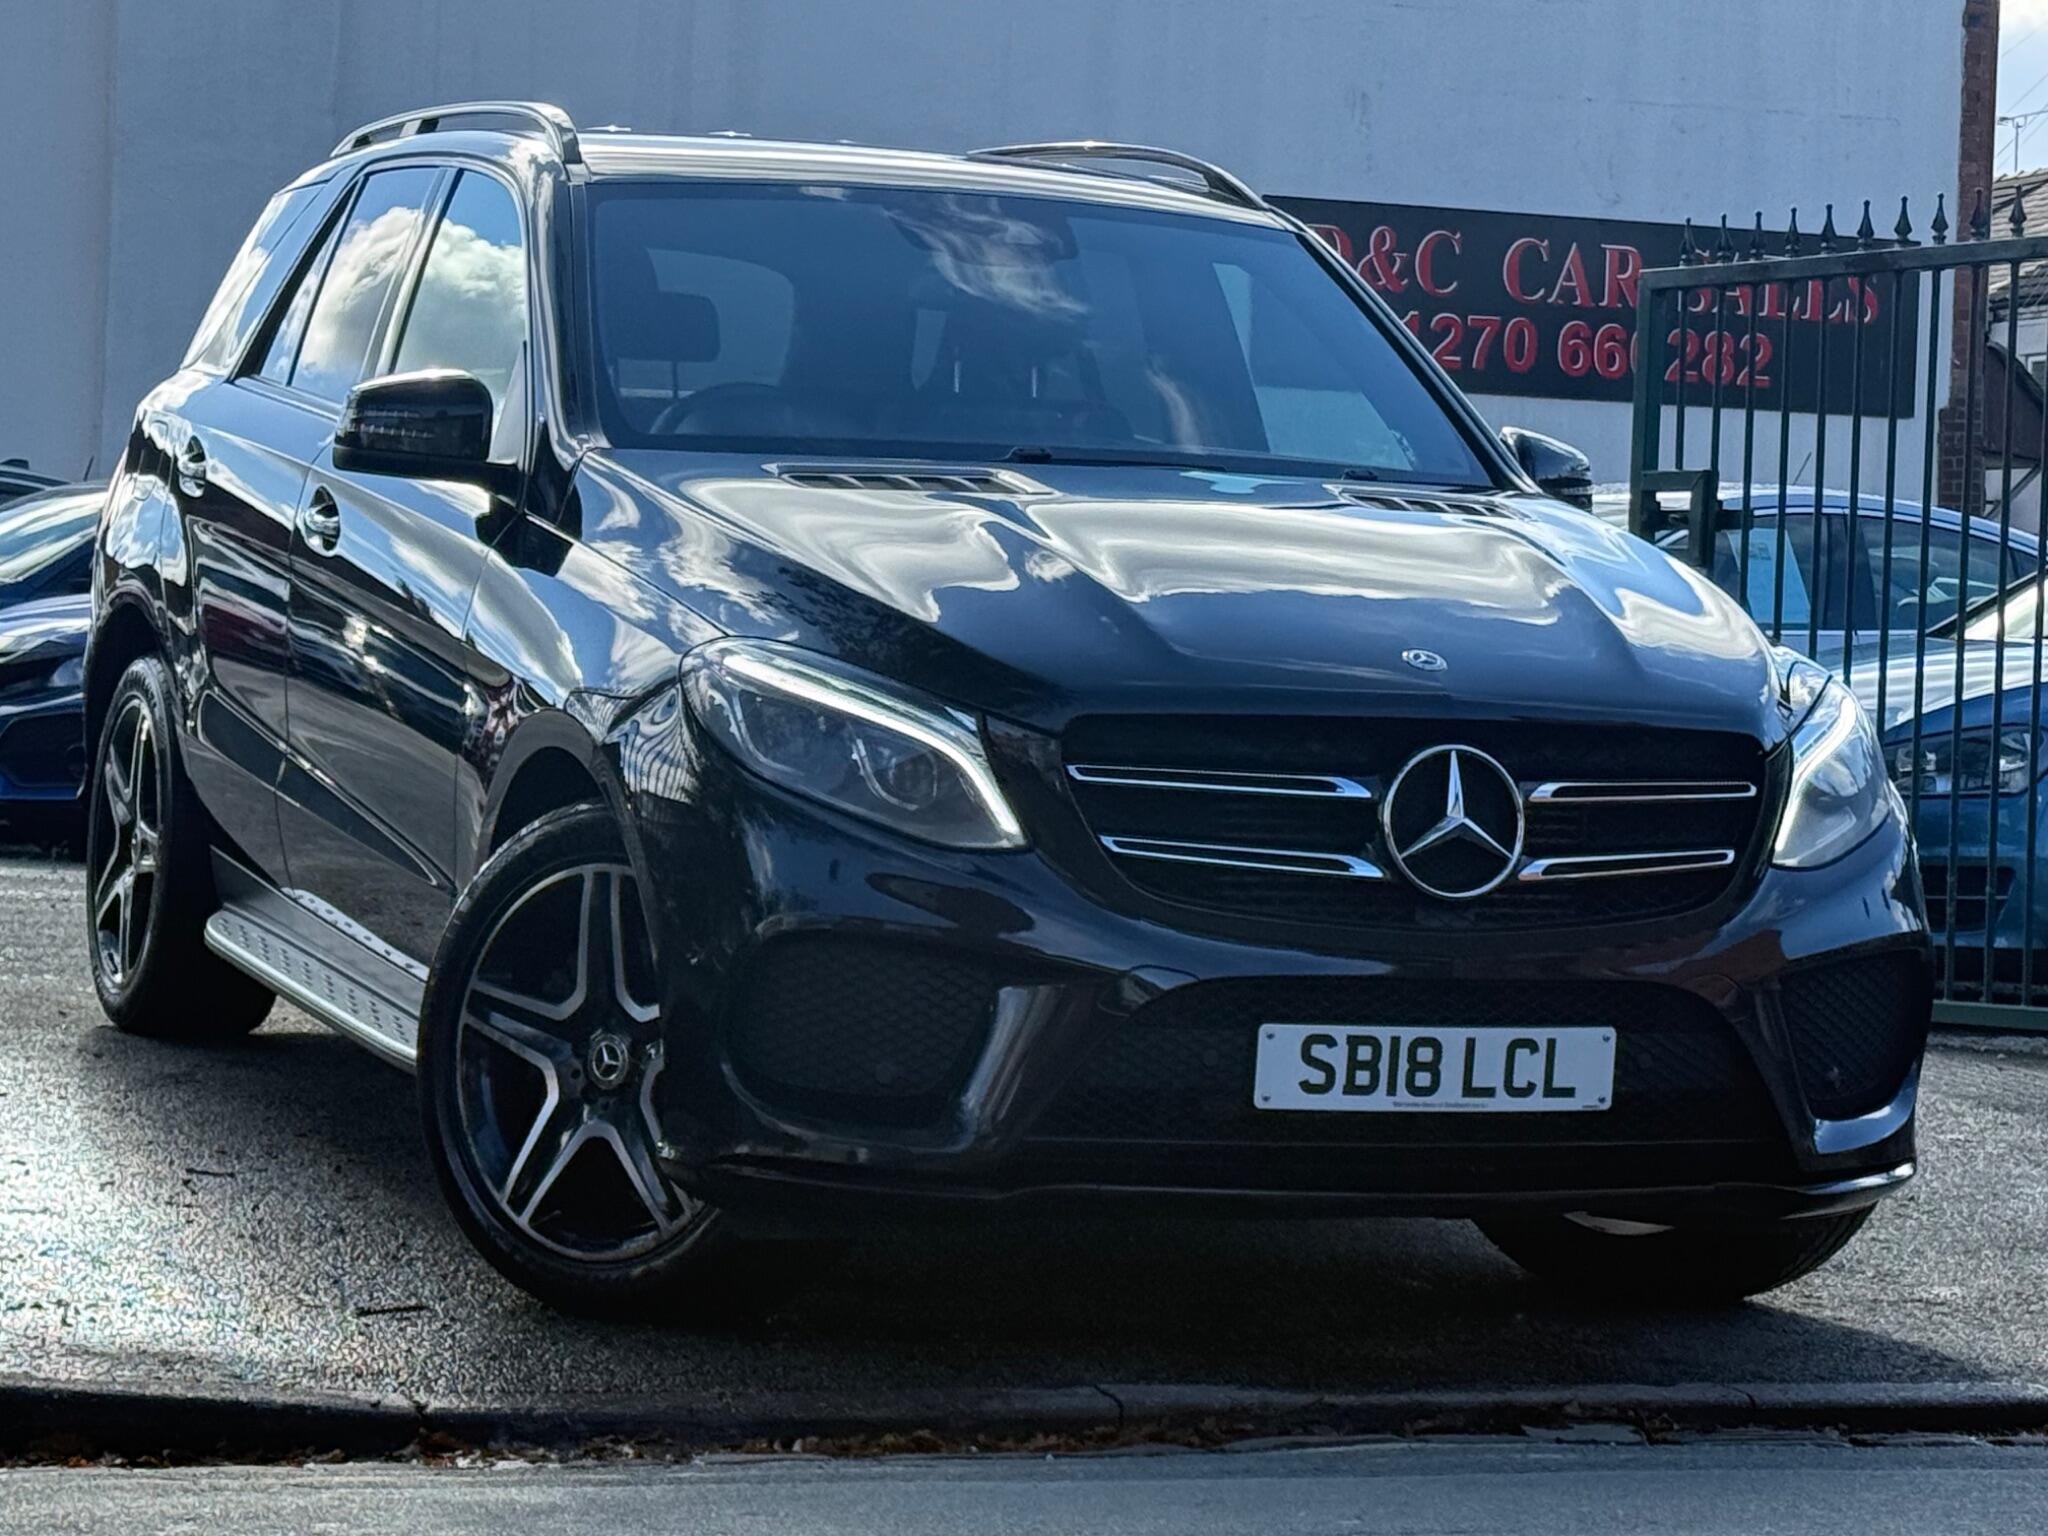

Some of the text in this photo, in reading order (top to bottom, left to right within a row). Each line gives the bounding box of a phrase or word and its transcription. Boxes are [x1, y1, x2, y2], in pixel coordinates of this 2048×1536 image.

[1502, 237, 1643, 308] CAR
[1557, 320, 1639, 379] 66
[1664, 327, 1773, 388] 282
[1298, 1033, 1577, 1099] SB18 LCL
